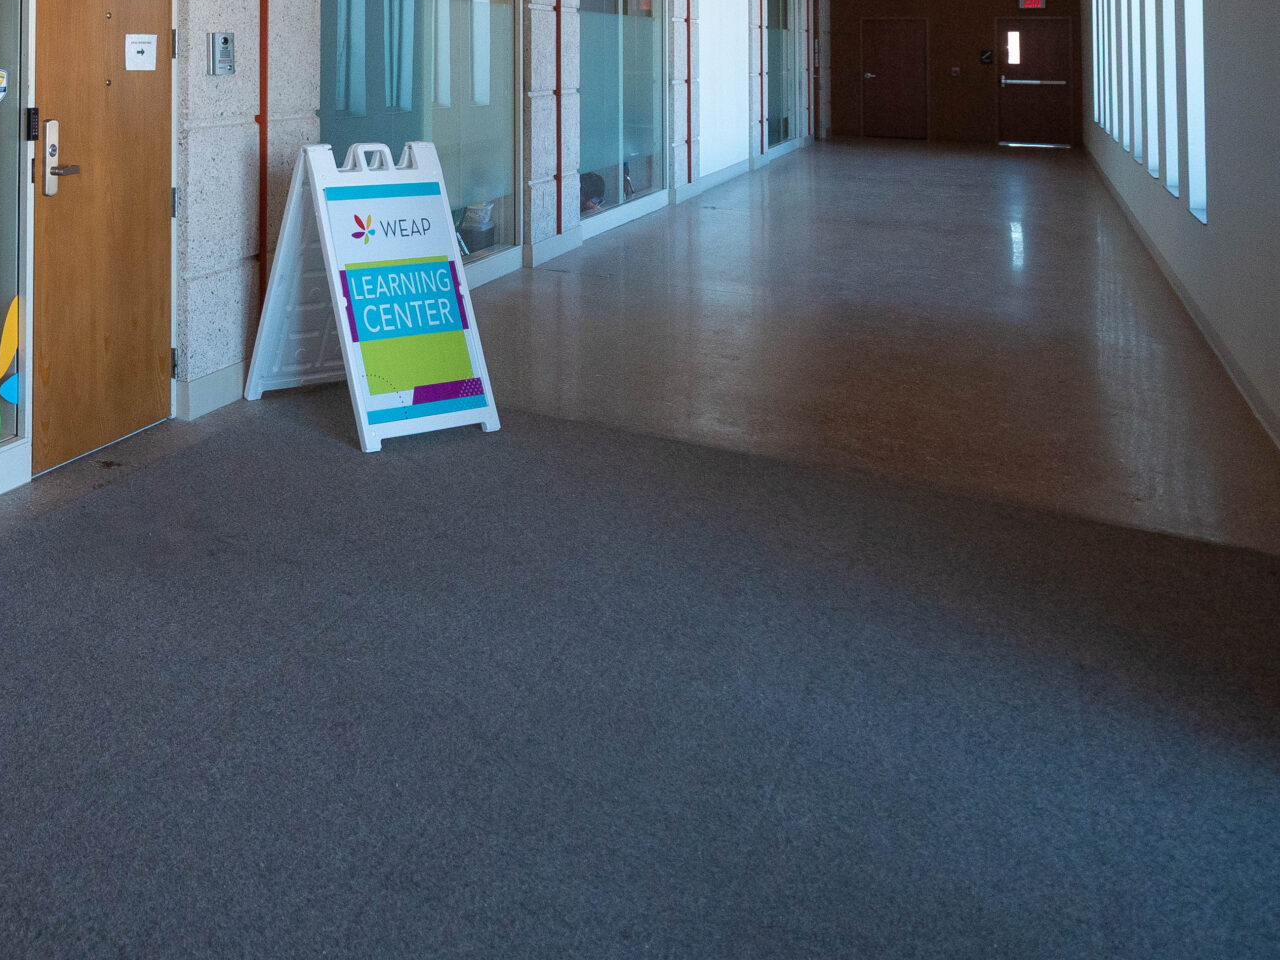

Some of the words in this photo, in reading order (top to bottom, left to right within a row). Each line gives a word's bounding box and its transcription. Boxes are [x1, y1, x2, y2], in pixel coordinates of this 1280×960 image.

[379, 218, 432, 238] WEAP
[350, 268, 451, 300] LEARNING
[363, 300, 454, 333] CENTER
